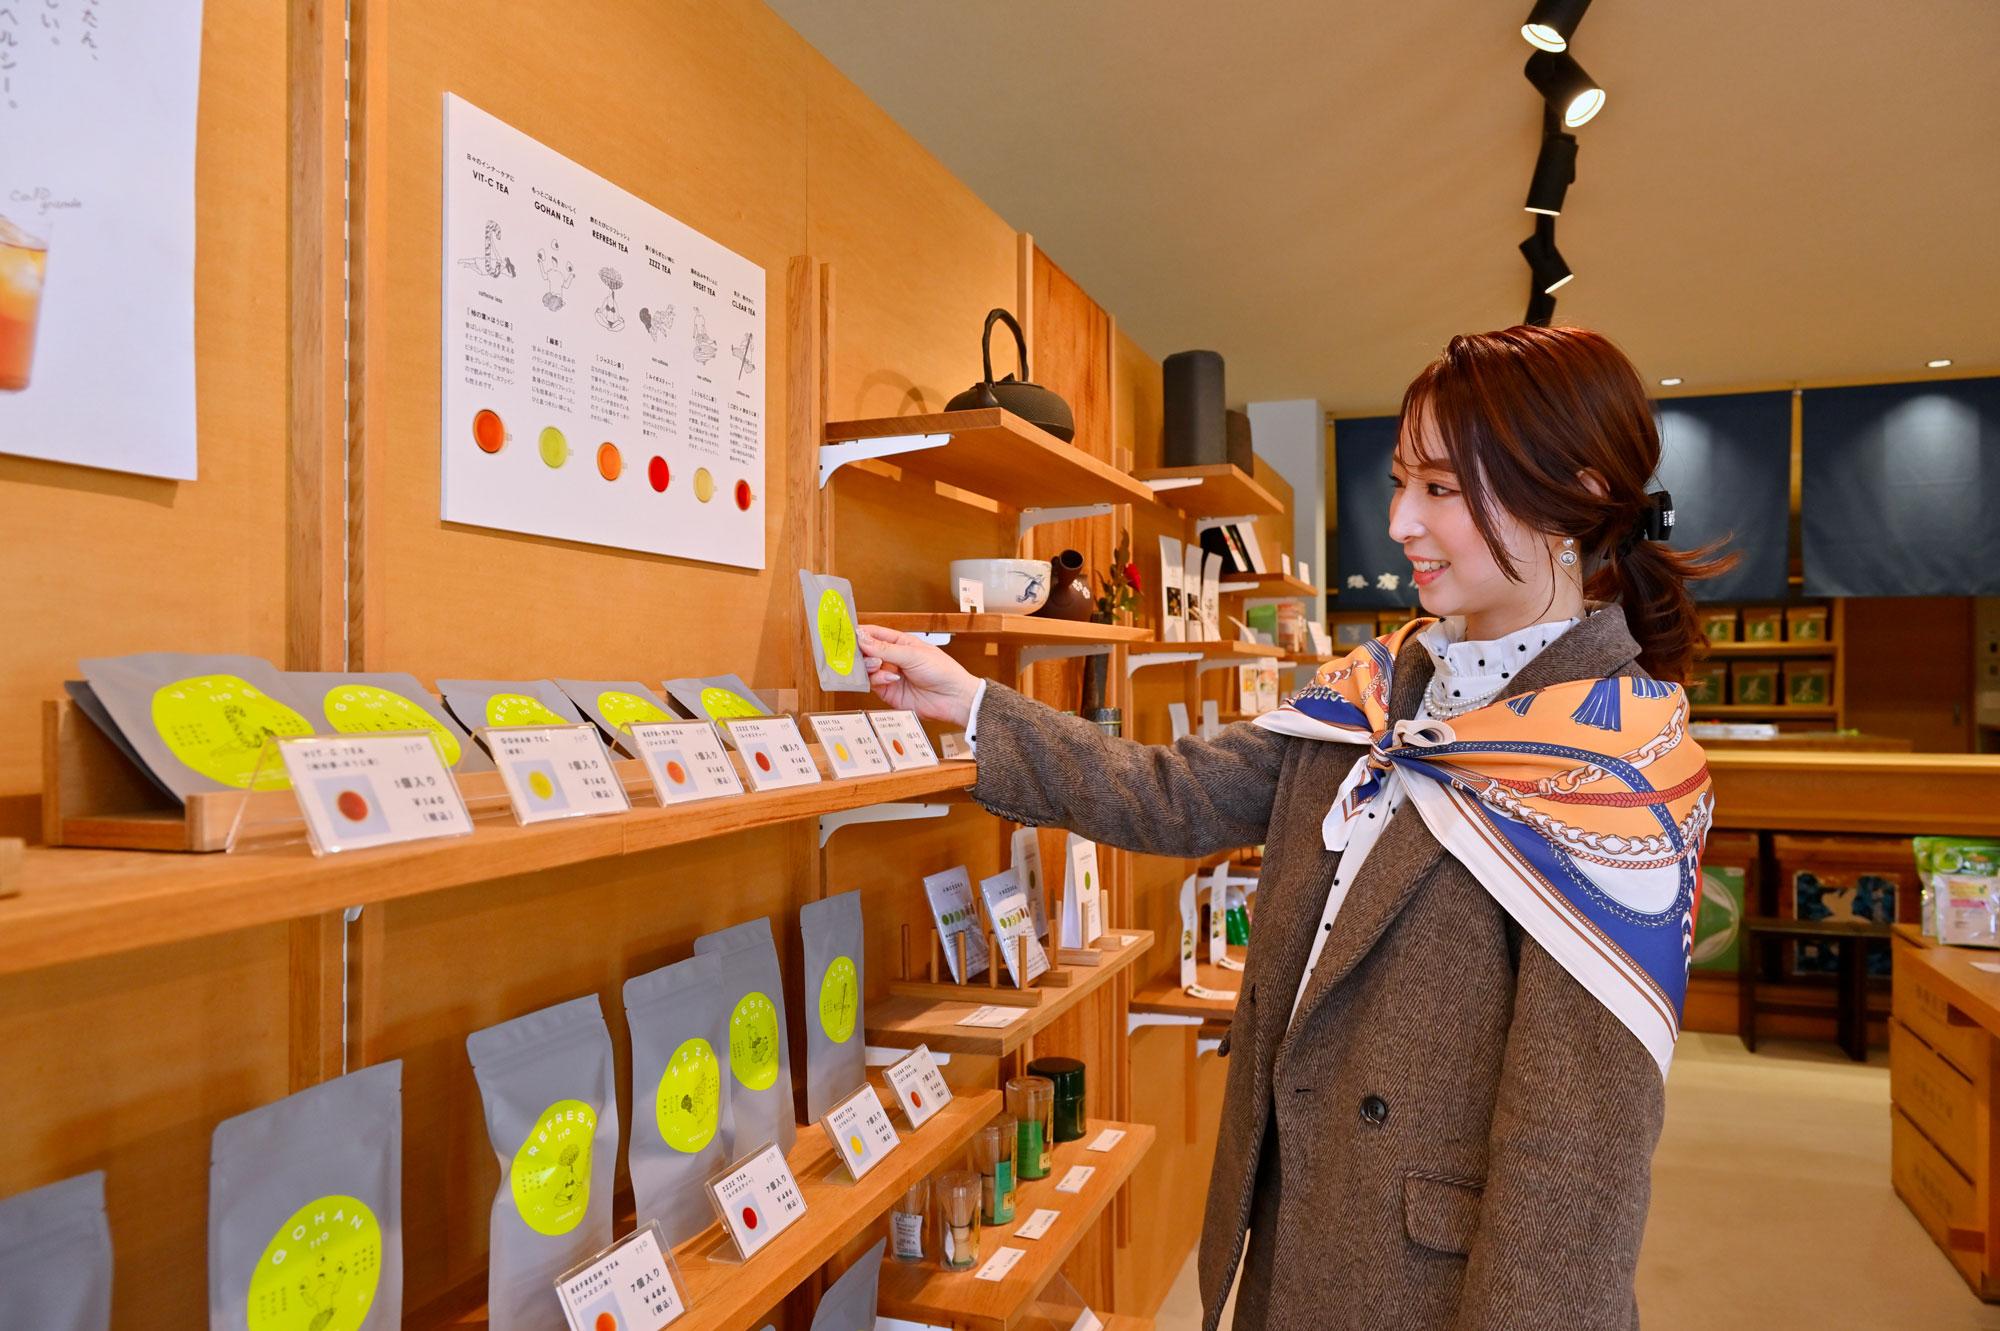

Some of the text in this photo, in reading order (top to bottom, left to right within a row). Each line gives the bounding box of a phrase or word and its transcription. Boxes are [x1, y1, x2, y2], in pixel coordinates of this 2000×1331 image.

[472, 170, 509, 195] VIT-C TEA
[534, 201, 575, 227] GOHAN TEA
[592, 230, 629, 254] REFRESH TEA
[649, 258, 672, 275] ZZZZ TEA
[693, 280, 716, 297] RESET TEA
[731, 300, 756, 317] CLEAR TEA
[528, 1110, 594, 1157] REFRESH
[766, 1174, 787, 1193] 7個入り
[272, 1208, 364, 1265] GOHAN
[570, 1260, 620, 1295] REFRESH TEA
[630, 1267, 660, 1293] 7個入り
[652, 1297, 673, 1317] (税込)
